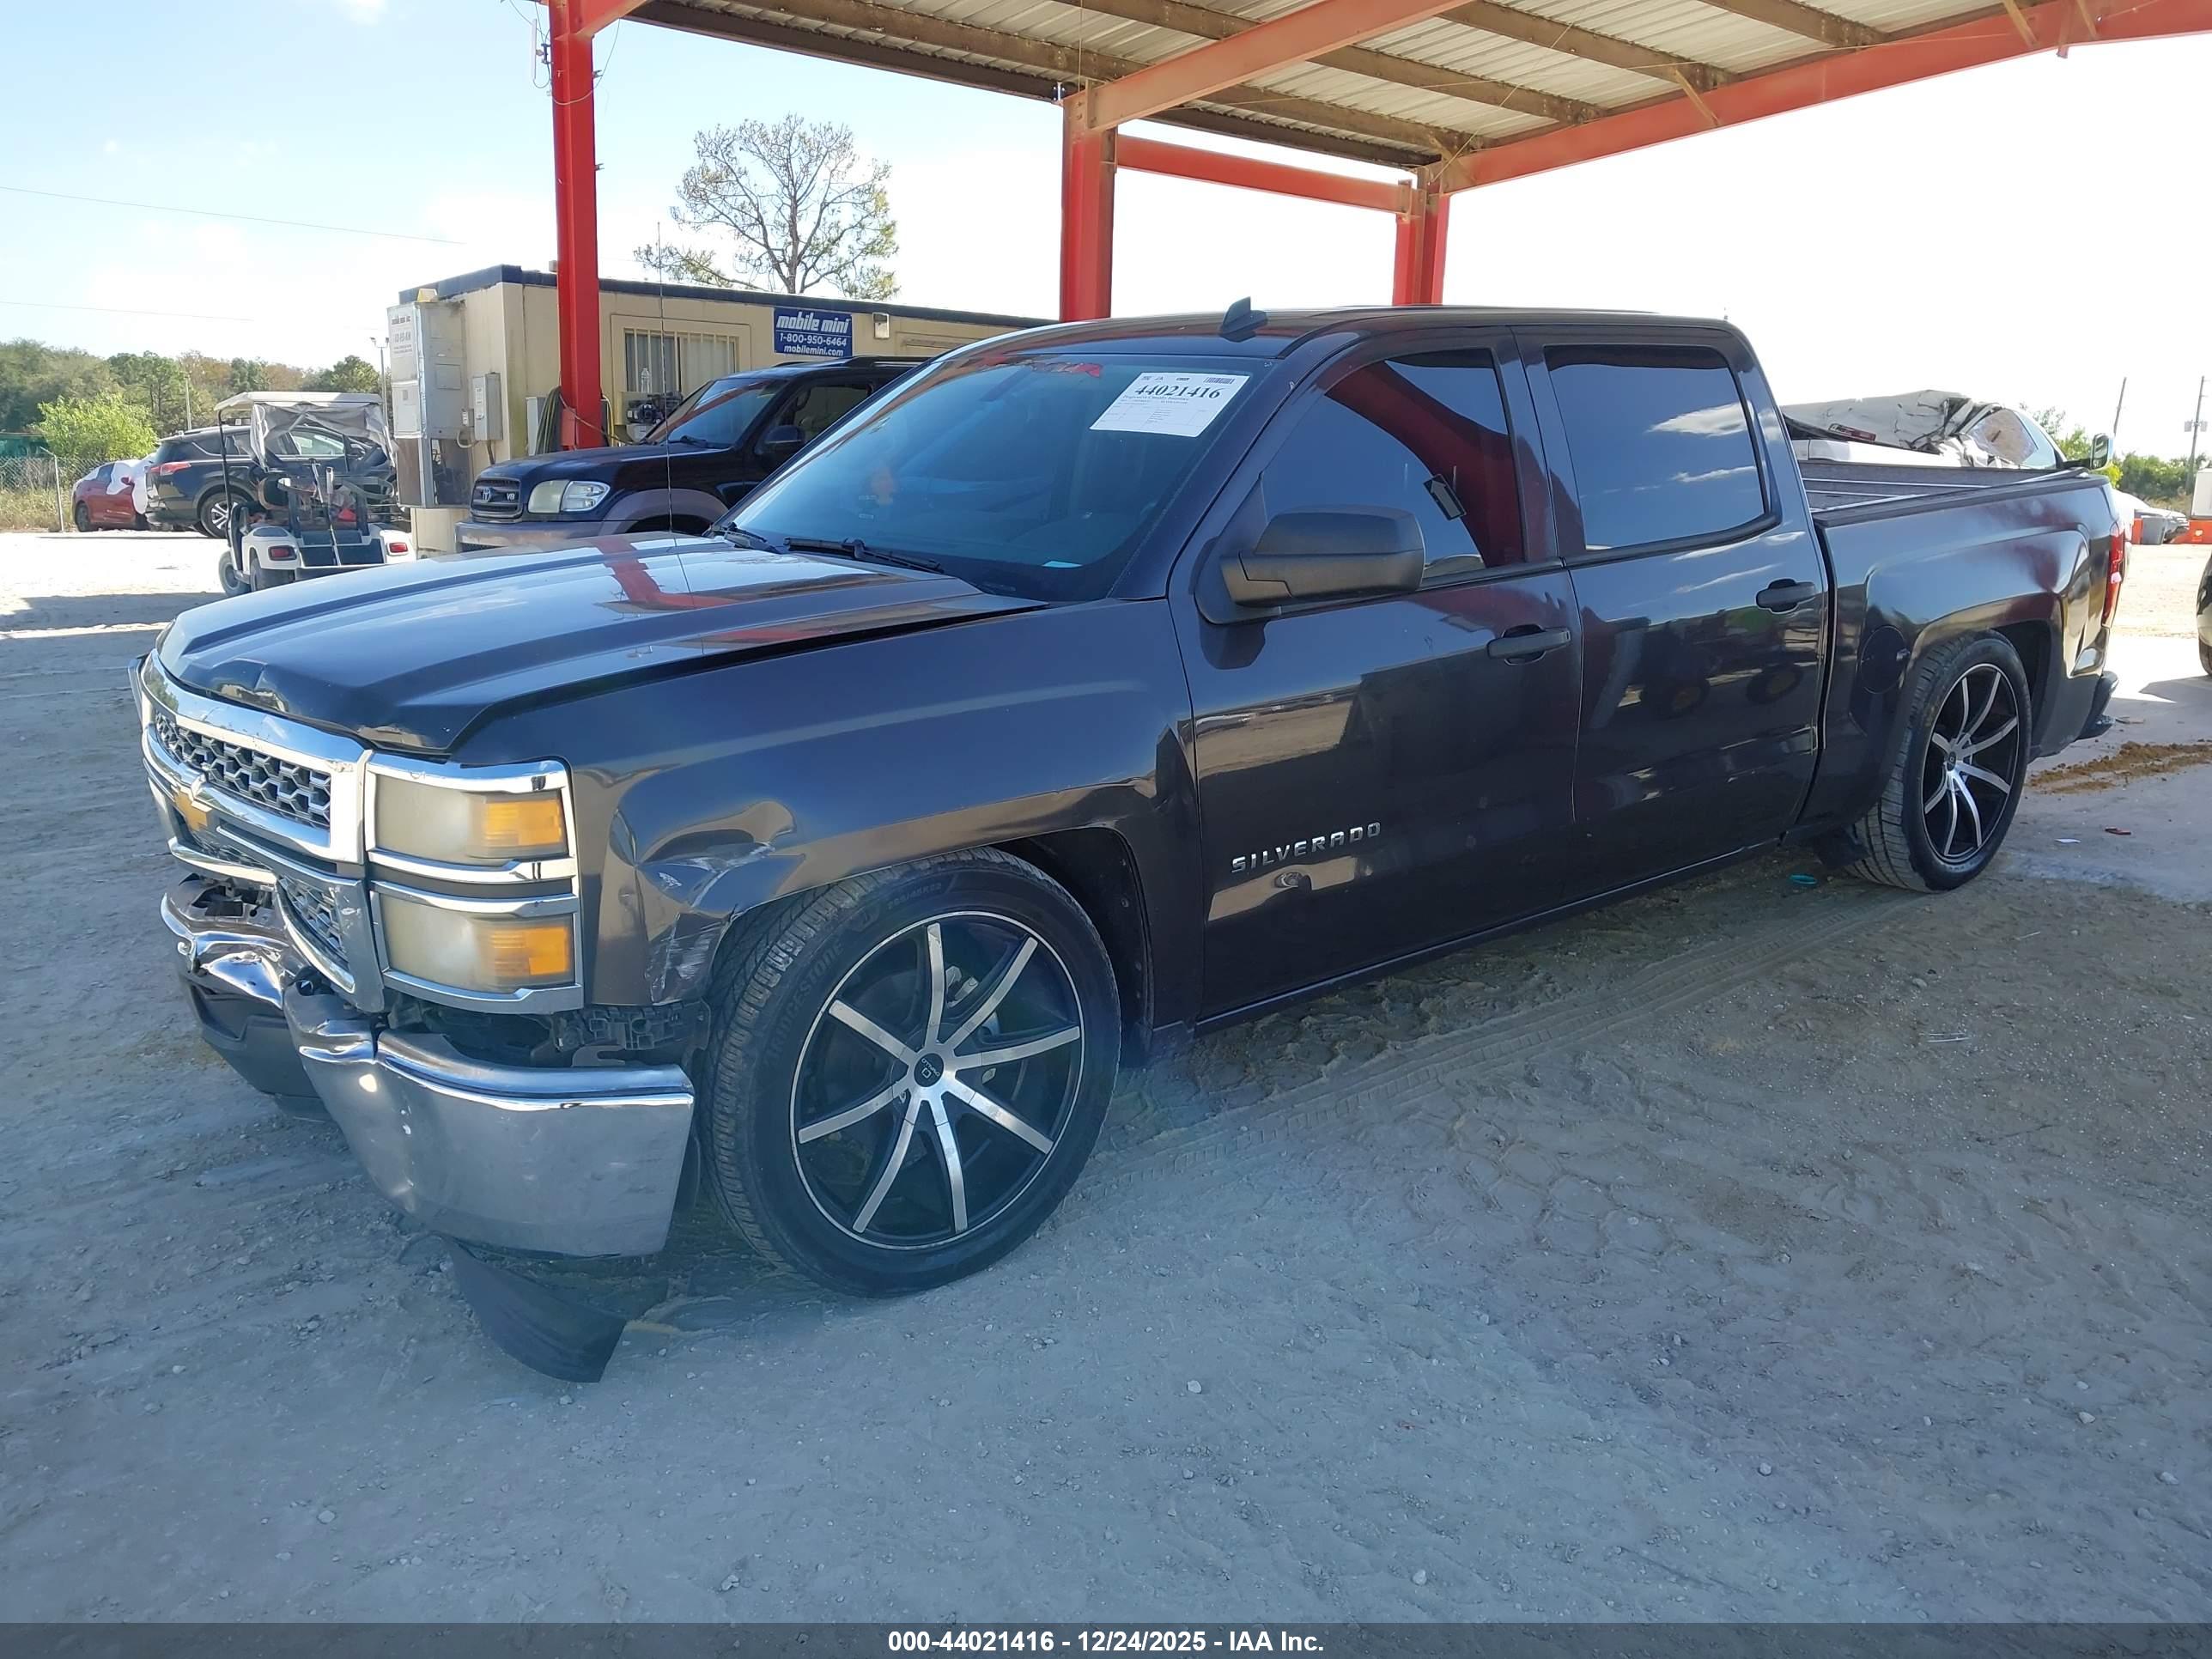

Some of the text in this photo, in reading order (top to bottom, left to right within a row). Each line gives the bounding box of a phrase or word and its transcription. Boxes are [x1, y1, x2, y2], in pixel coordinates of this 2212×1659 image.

[776, 312, 850, 333] mobile mini
[780, 332, 847, 347] 1-800-950-6464
[783, 344, 844, 356] mobilemini.com
[1134, 384, 1231, 399] 44021416
[1231, 822, 1381, 873] SILVERADO
